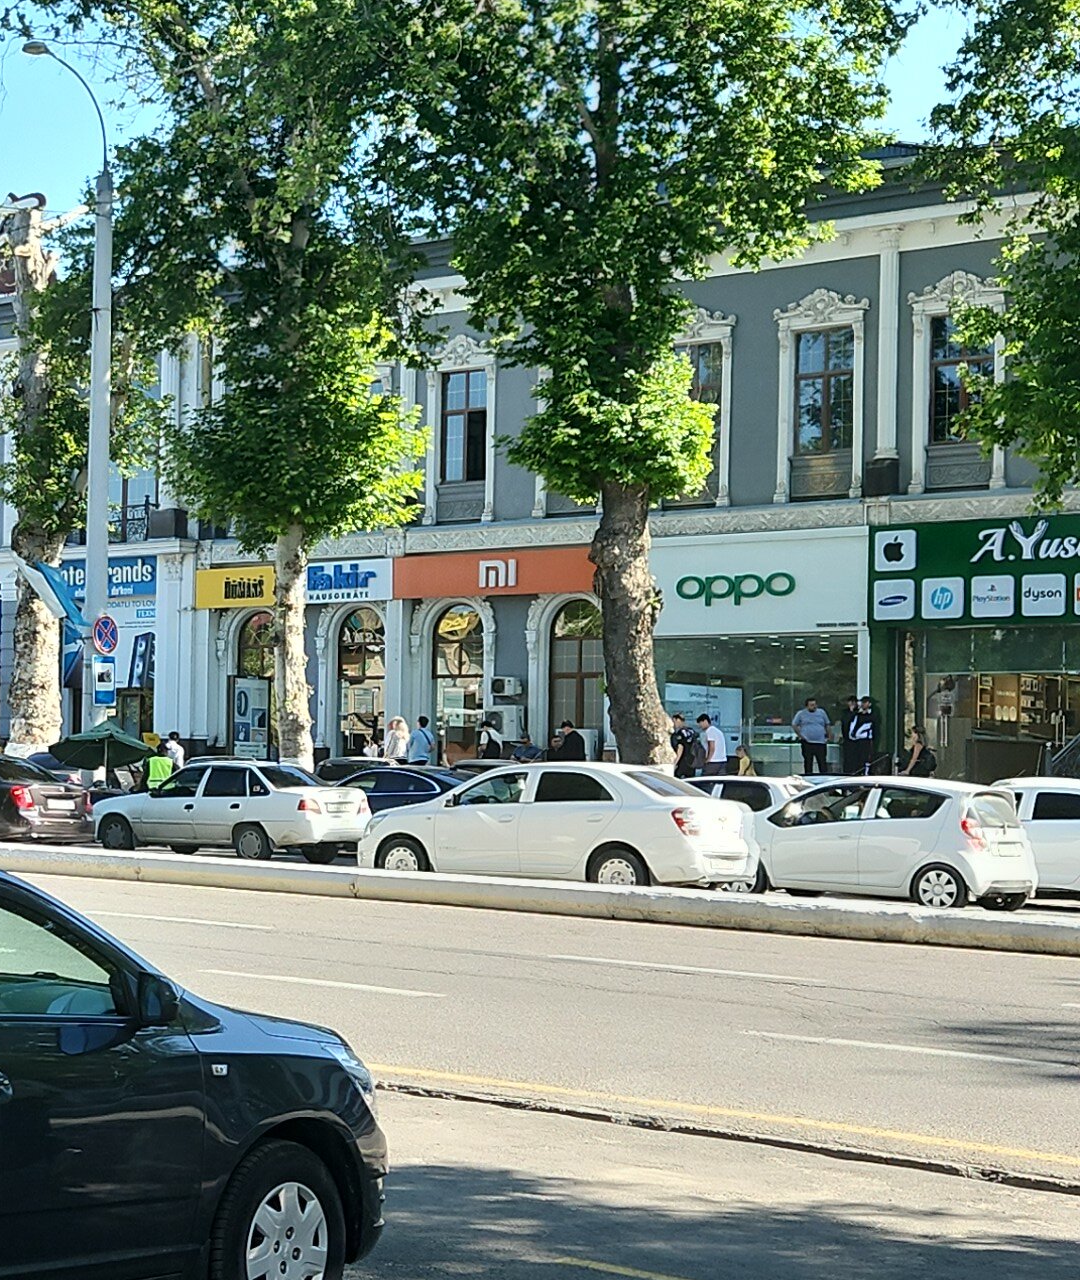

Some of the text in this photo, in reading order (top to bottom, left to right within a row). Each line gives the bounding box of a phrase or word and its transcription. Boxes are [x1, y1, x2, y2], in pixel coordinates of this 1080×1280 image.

[969, 519, 1080, 563] A.Yus
[307, 563, 377, 591] Fakir
[933, 587, 952, 610] hp
[973, 595, 1010, 603] PlayStation
[1023, 587, 1062, 602] dyson
